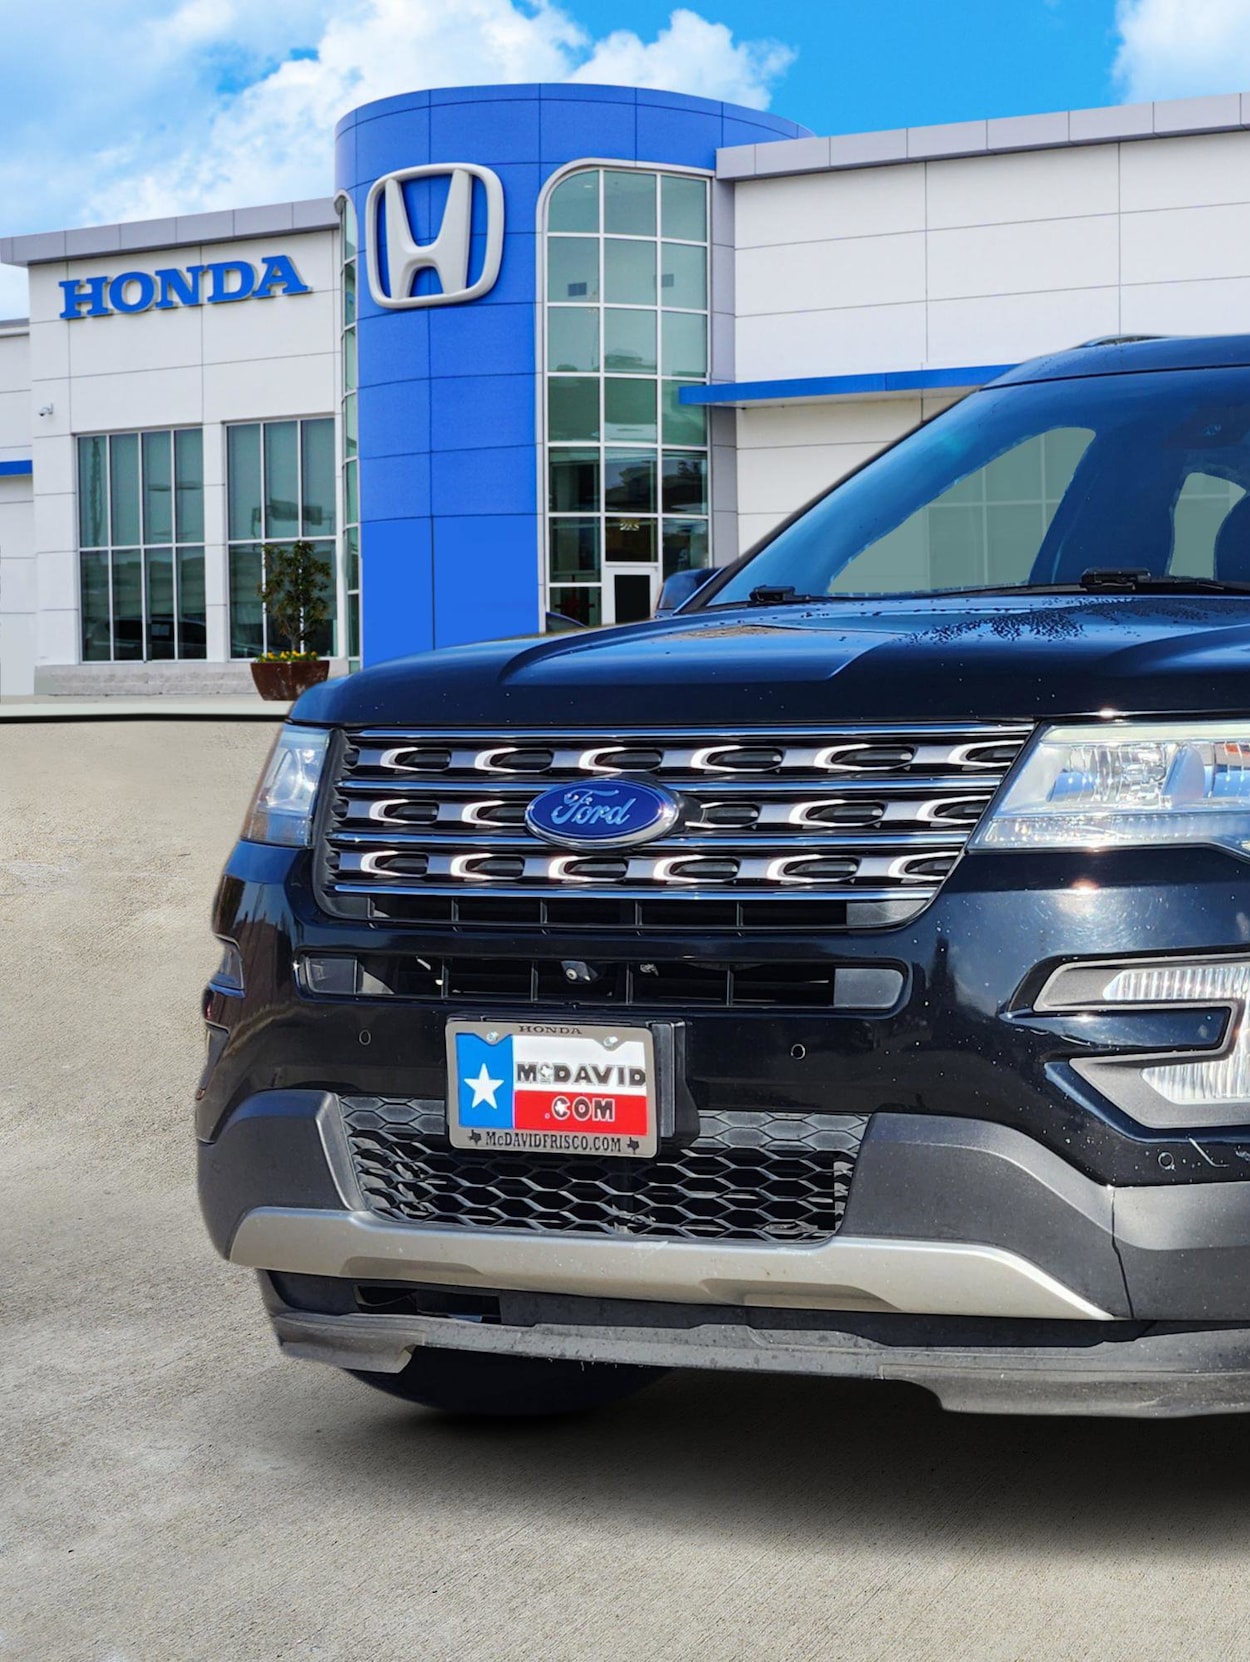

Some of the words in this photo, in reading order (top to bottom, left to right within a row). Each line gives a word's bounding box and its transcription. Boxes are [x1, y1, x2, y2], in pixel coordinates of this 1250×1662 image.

[59, 255, 310, 319] HONDA
[551, 788, 636, 825] Ford
[518, 1025, 583, 1035] HONDA
